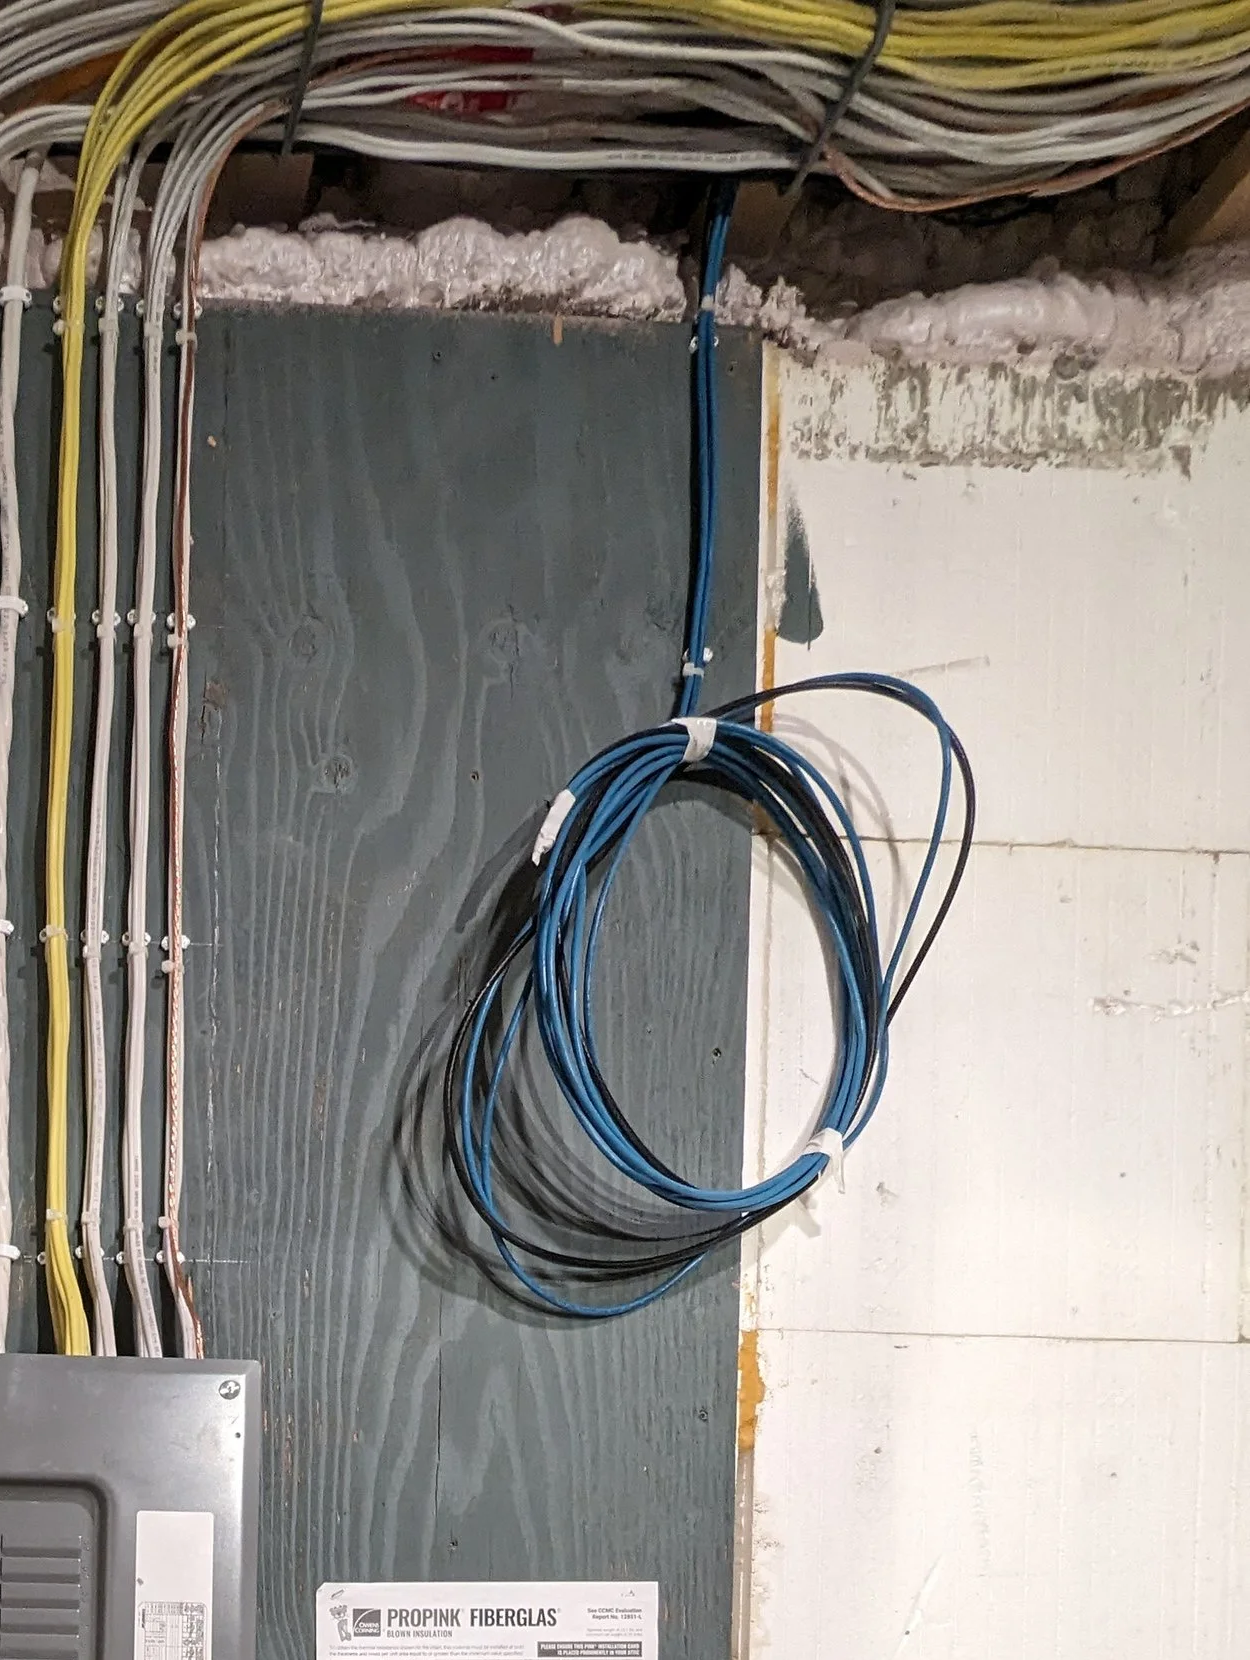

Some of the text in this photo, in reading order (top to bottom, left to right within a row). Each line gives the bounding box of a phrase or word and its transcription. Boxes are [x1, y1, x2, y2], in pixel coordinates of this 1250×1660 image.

[388, 1608, 557, 1627] PROPINK FIBERGLAS
[387, 1630, 453, 1638] BLOWN INSULATION
